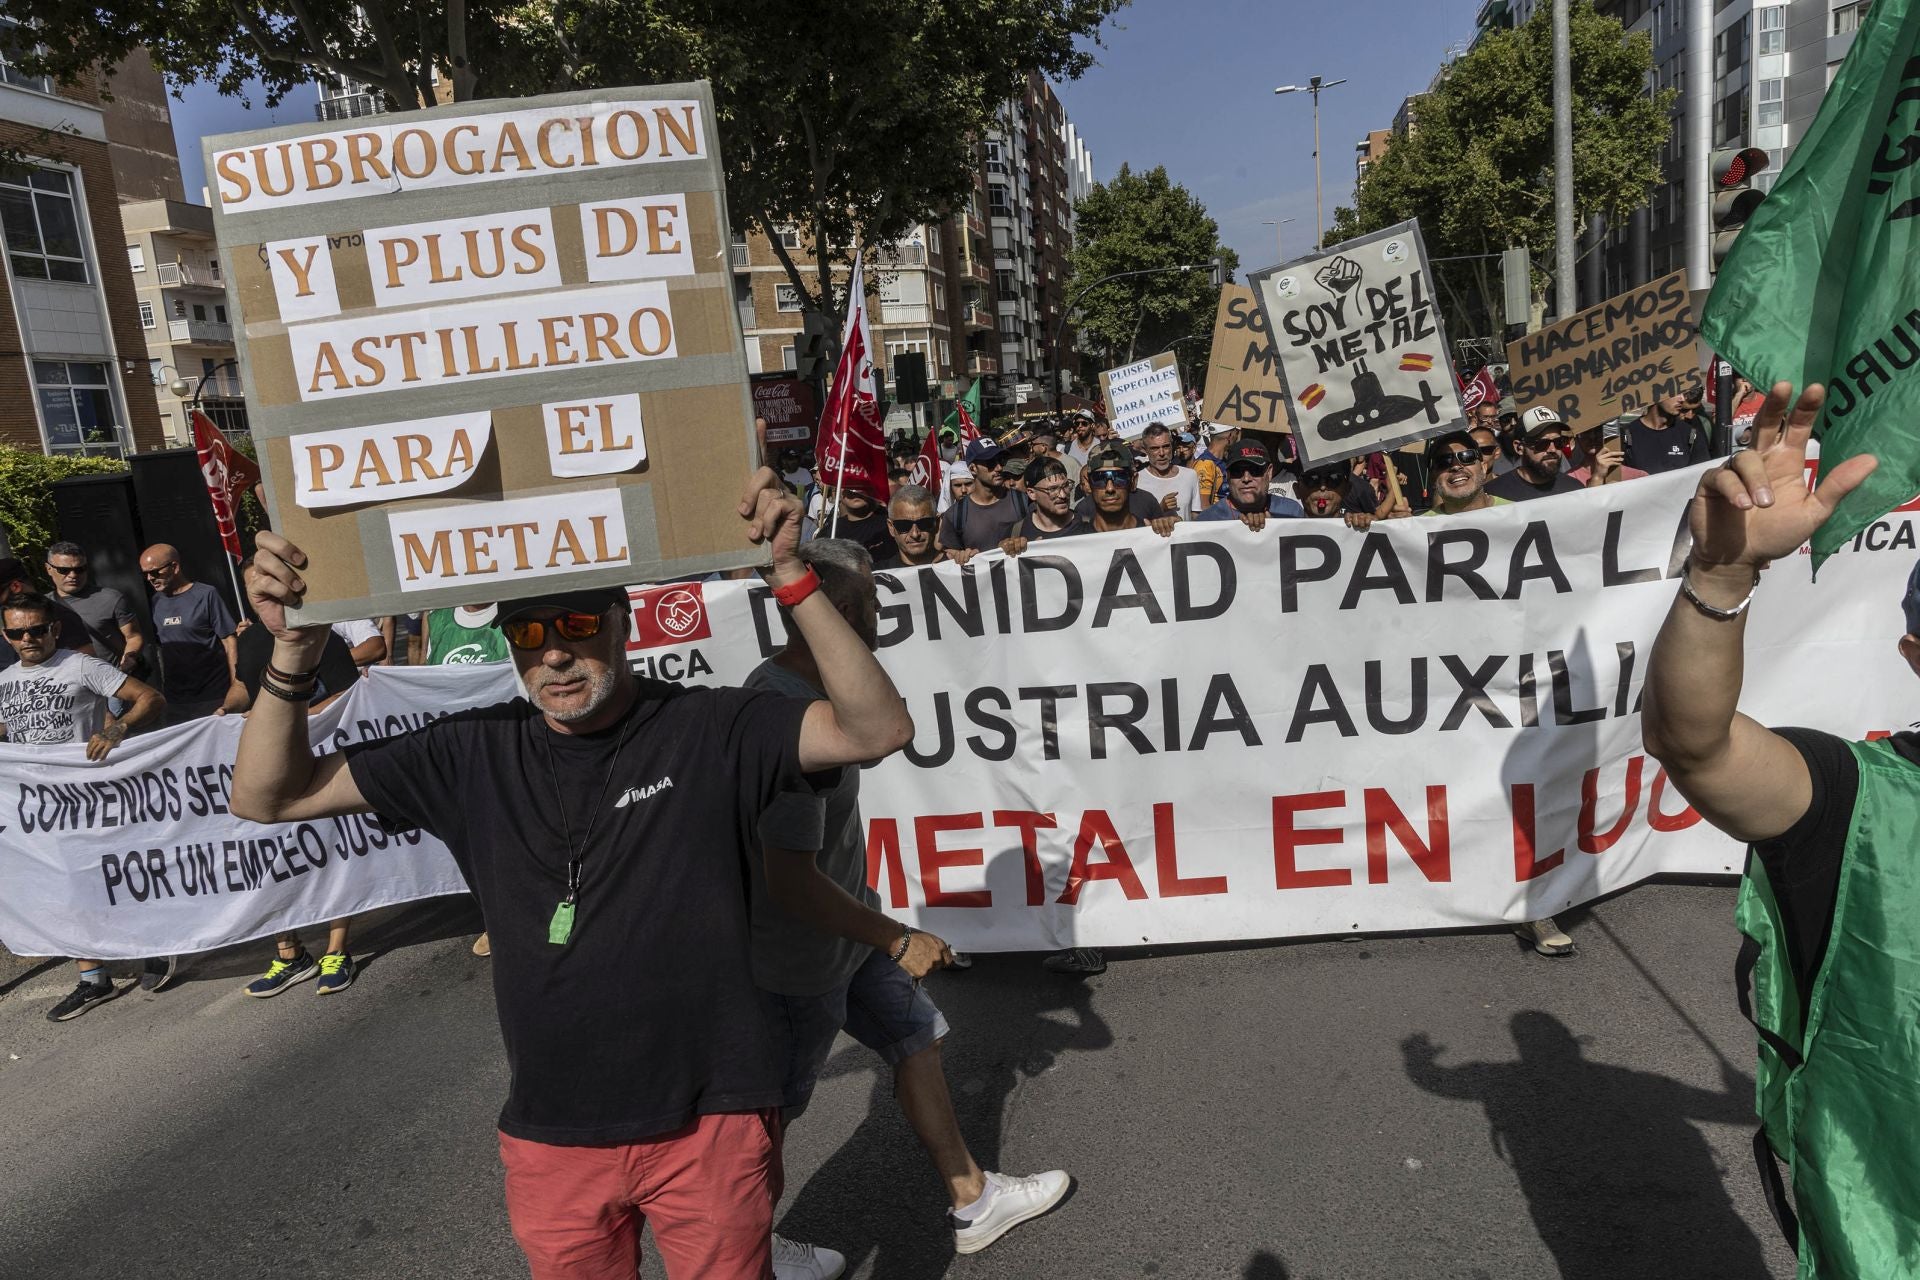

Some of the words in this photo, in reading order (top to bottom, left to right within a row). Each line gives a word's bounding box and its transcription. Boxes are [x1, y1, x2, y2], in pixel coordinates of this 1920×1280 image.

[217, 106, 699, 205] SUBROGACION
[275, 245, 320, 297] Y
[379, 223, 546, 288] PLUS
[591, 205, 682, 257] DE
[1283, 296, 1346, 346] SOY
[1366, 270, 1431, 320] DEL
[1520, 275, 1686, 367] HACEMOS
[308, 307, 672, 394] ASTILLERO
[1110, 361, 1151, 382] PLUSES
[1311, 310, 1435, 373] METAL
[1111, 369, 1176, 397] ESPECIALES
[1116, 399, 1146, 415] PARA
[1150, 390, 1171, 403] LAS
[1215, 384, 1284, 423] AST
[1601, 356, 1674, 401] 1000€
[1621, 390, 1648, 413] AL
[1652, 367, 1702, 402] MES
[305, 428, 474, 492] PARA
[553, 403, 633, 456] EL
[1115, 404, 1180, 431] AUXILIARES
[400, 516, 628, 581] METAL
[1279, 519, 1573, 614] PARA
[1837, 520, 1917, 553] ICA
[165, 616, 181, 626] FILA
[862, 673, 1263, 769] USTRIA
[1285, 641, 1643, 744] AUXILI
[17, 767, 182, 834] CONVENIOS
[631, 776, 674, 803] IMASA
[101, 848, 176, 906] POR
[175, 842, 220, 898] UN
[224, 822, 328, 893] EMPLEO
[1272, 785, 1452, 890] EN
